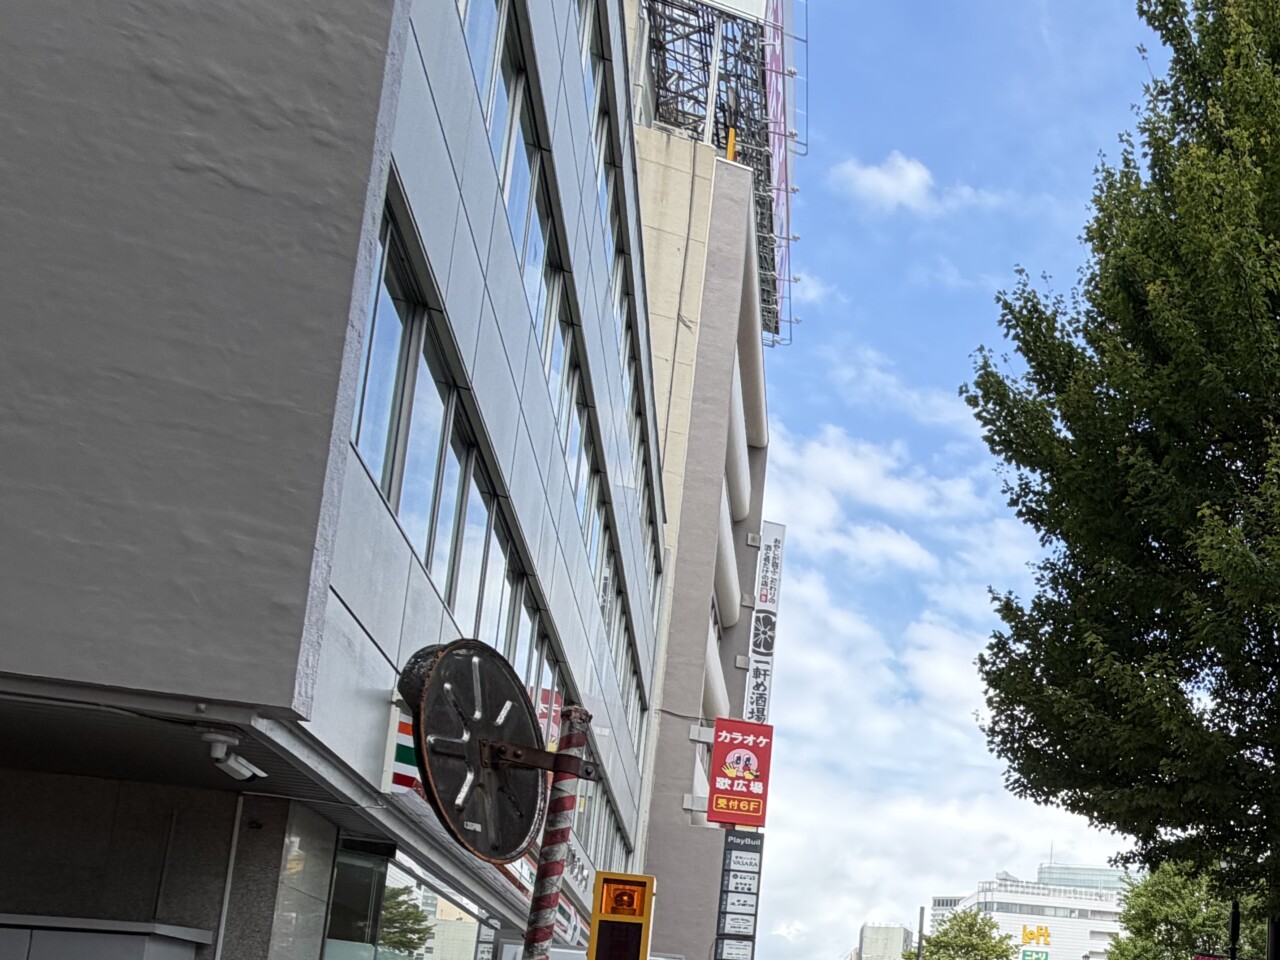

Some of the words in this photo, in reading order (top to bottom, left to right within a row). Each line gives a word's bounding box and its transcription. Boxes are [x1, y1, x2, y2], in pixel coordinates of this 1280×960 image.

[747, 660, 770, 724] 一軒め酒場
[718, 730, 770, 748] カラオケ
[715, 776, 764, 794] 歌広場
[717, 798, 759, 812] 受付6F
[1025, 951, 1046, 960] ニトリ
